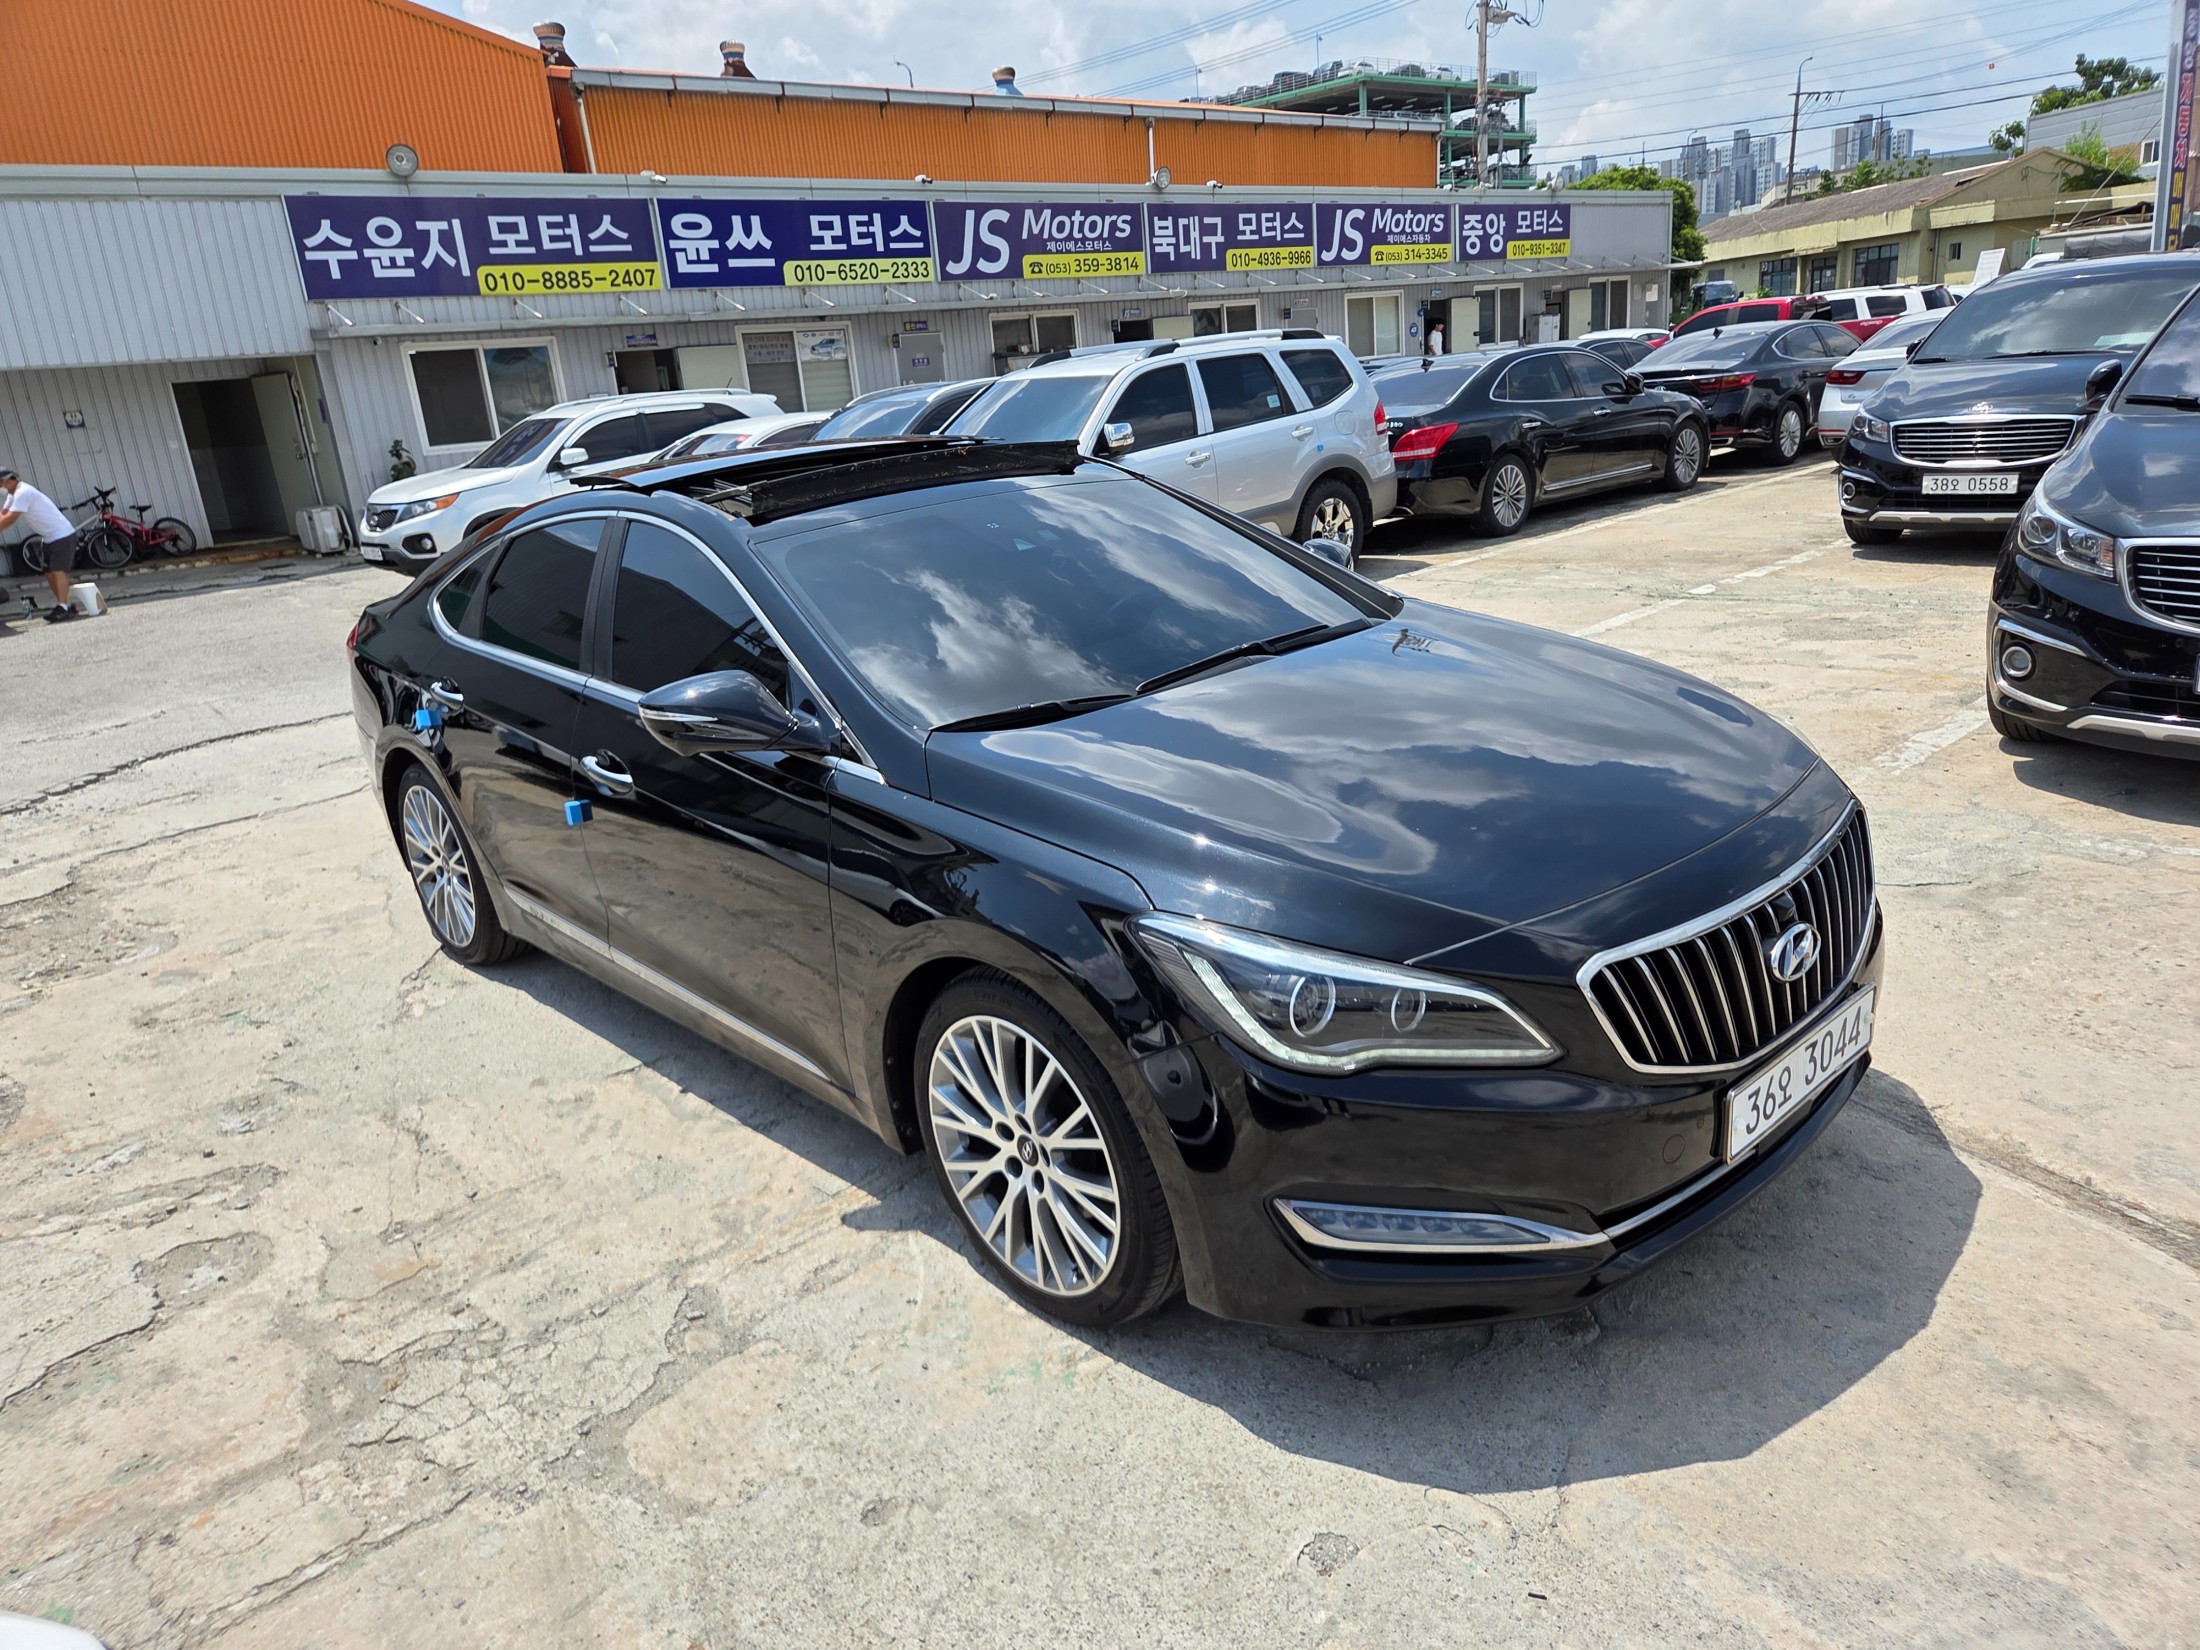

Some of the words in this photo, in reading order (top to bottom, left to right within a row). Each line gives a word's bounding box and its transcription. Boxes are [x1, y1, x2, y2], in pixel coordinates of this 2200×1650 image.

[669, 213, 776, 273] 윤쓰
[809, 213, 924, 251] 모터스
[945, 209, 1011, 275] JS
[1022, 209, 1132, 239] Motors
[1152, 216, 1225, 261] 북대구
[1237, 212, 1305, 241] 모터스
[1320, 208, 1366, 262] JS
[1371, 208, 1444, 233] Motors
[1387, 234, 1431, 244] 제이에스자동차
[1462, 213, 1506, 255] 중앙
[1516, 209, 1564, 234] 모터스
[303, 216, 471, 279] 수윤지
[488, 213, 633, 256] 모터스
[1046, 240, 1112, 253] 제이에스모터스
[1385, 251, 1403, 262] (053)
[1404, 247, 1448, 260] 314-3345
[1512, 242, 1566, 256] 010-9351-3347
[1045, 262, 1071, 275] (053)
[1074, 257, 1139, 273] 359-3814
[1231, 251, 1311, 267] 010-4936-9966
[484, 268, 656, 292] 010-8885-2407
[794, 261, 930, 282] 010-6520-2333
[1930, 478, 1959, 492] 38오
[1967, 476, 2009, 492] 0558
[1745, 1066, 1793, 1135] 36오
[1805, 1005, 1862, 1086] 3044
